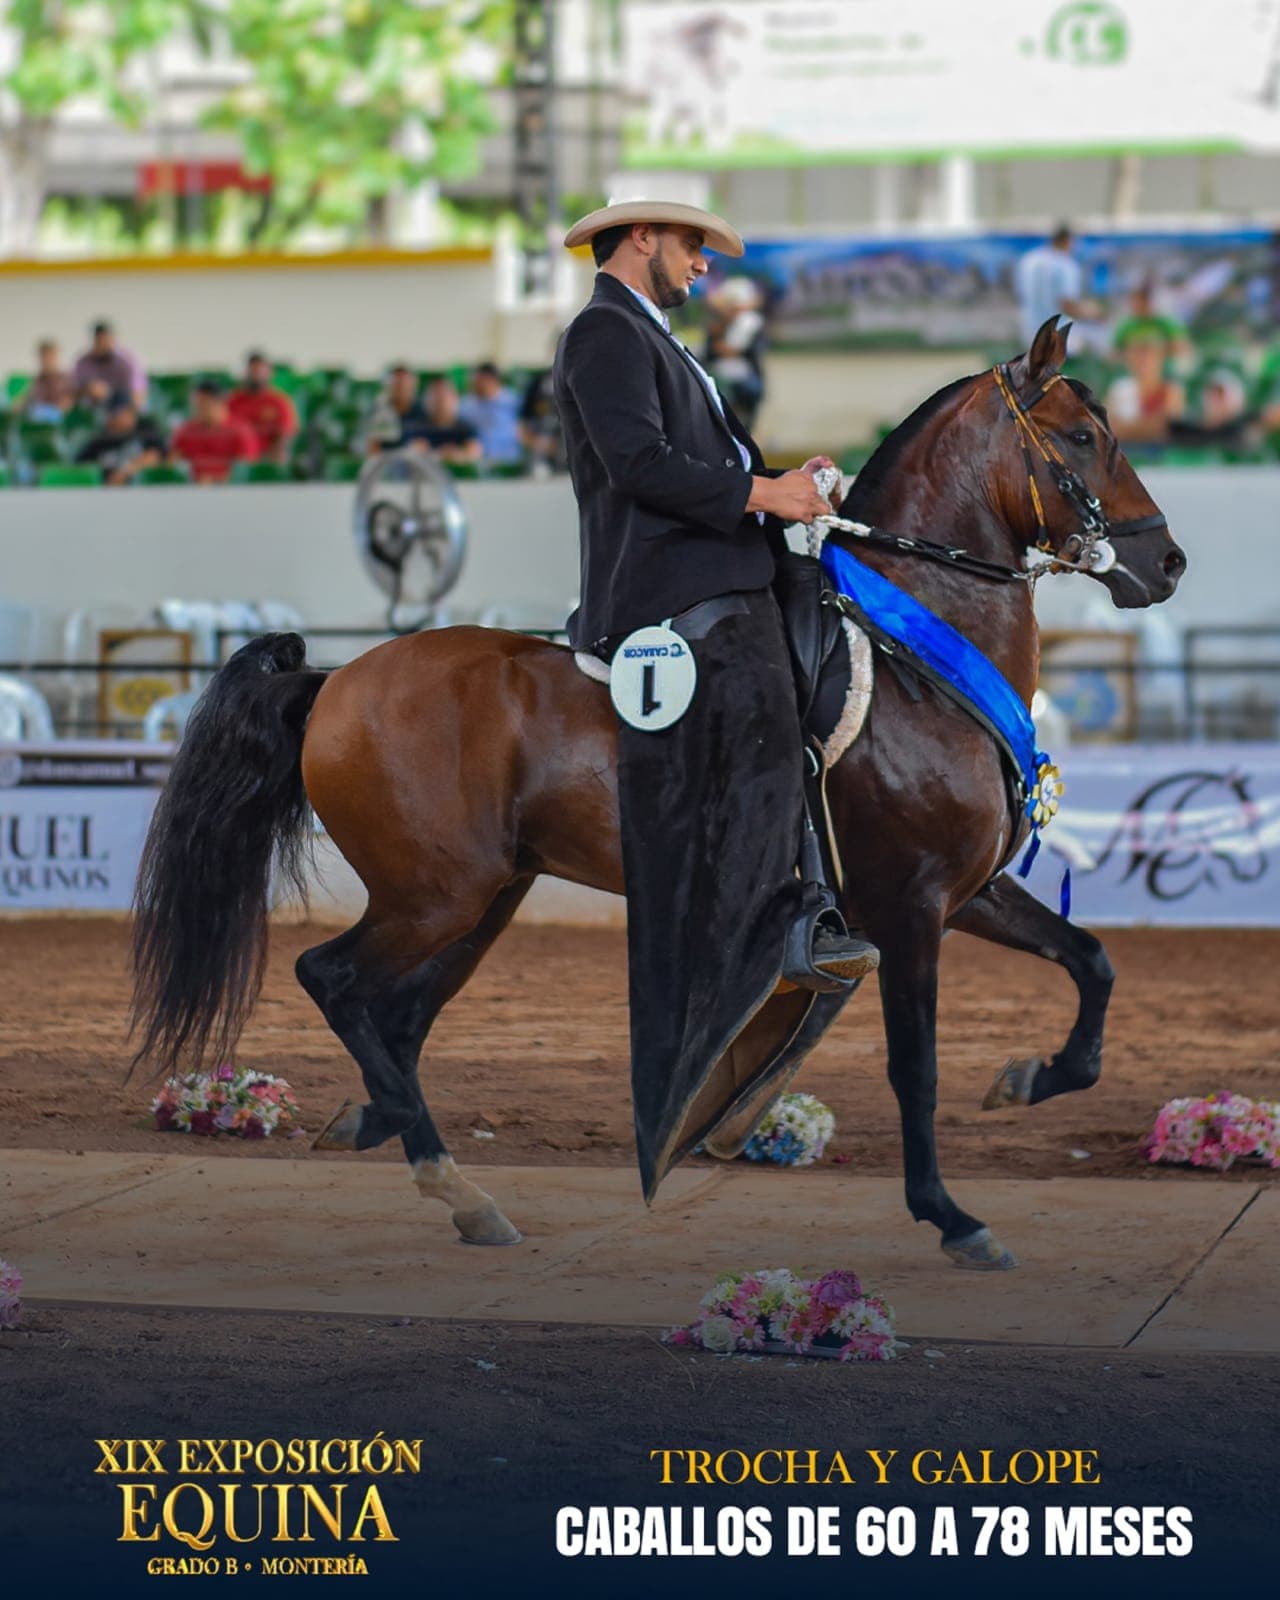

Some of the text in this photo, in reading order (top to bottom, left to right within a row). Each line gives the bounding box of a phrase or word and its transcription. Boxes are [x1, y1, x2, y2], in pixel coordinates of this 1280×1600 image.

[642, 665, 662, 716] 1
[0, 816, 109, 860] UEL
[0, 867, 109, 896] QUINOS
